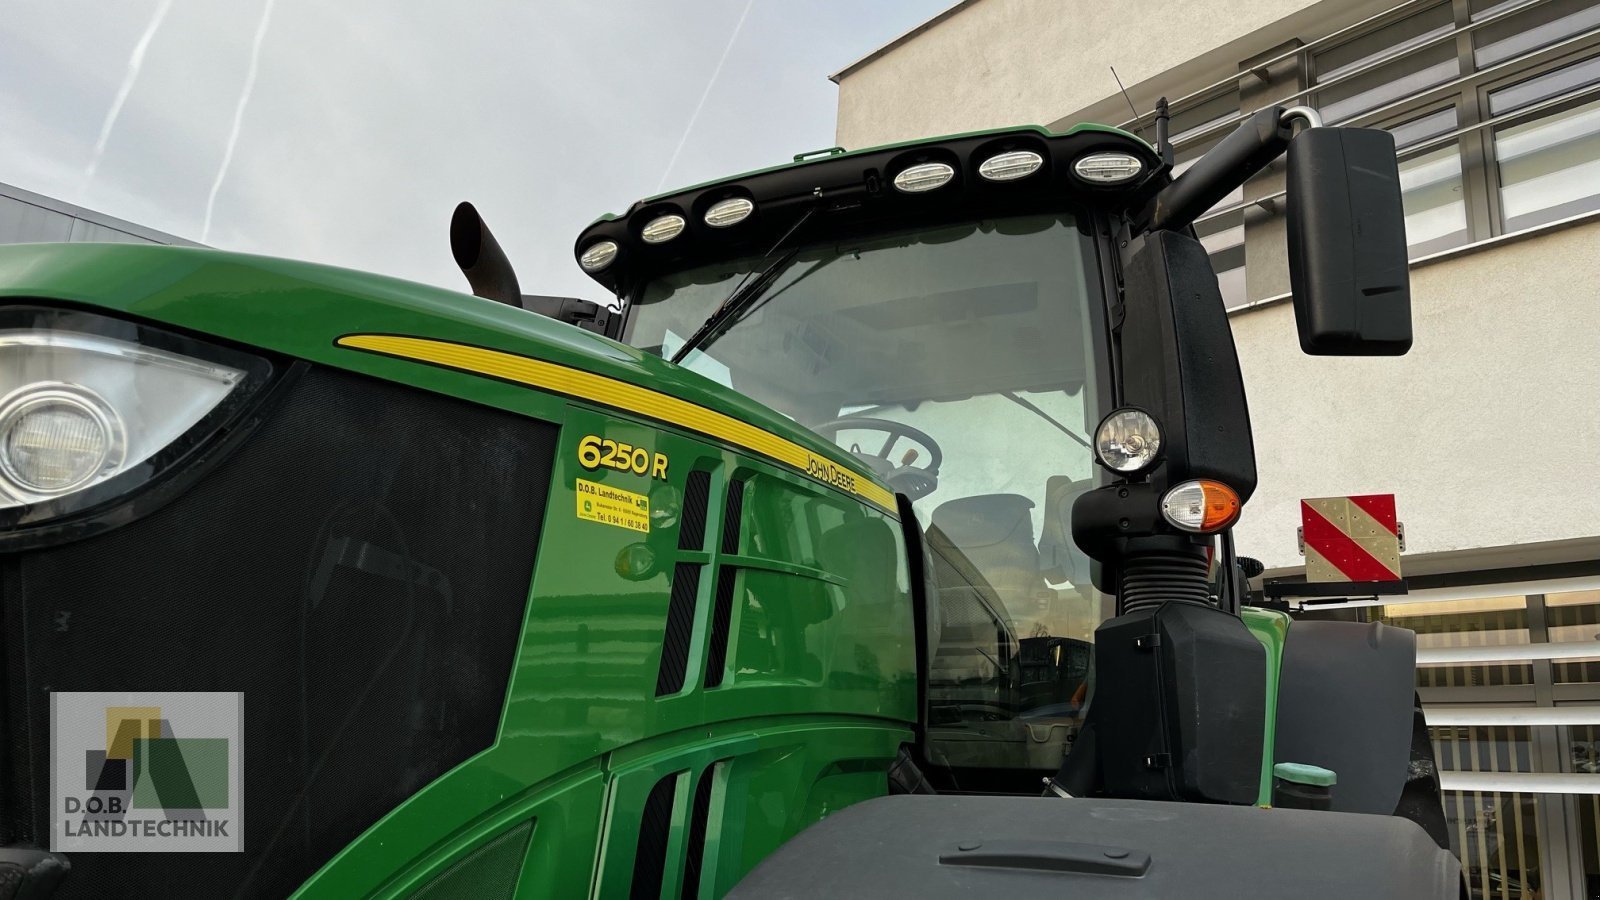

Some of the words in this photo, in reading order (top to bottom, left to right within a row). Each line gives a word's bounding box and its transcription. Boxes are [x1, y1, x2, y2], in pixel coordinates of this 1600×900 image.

[578, 434, 649, 476] 6250
[652, 452, 668, 480] R
[806, 453, 830, 480] JOHN
[830, 464, 856, 493] DEERE
[578, 482, 597, 496] D.O.B.
[598, 487, 633, 504] Landtechnik
